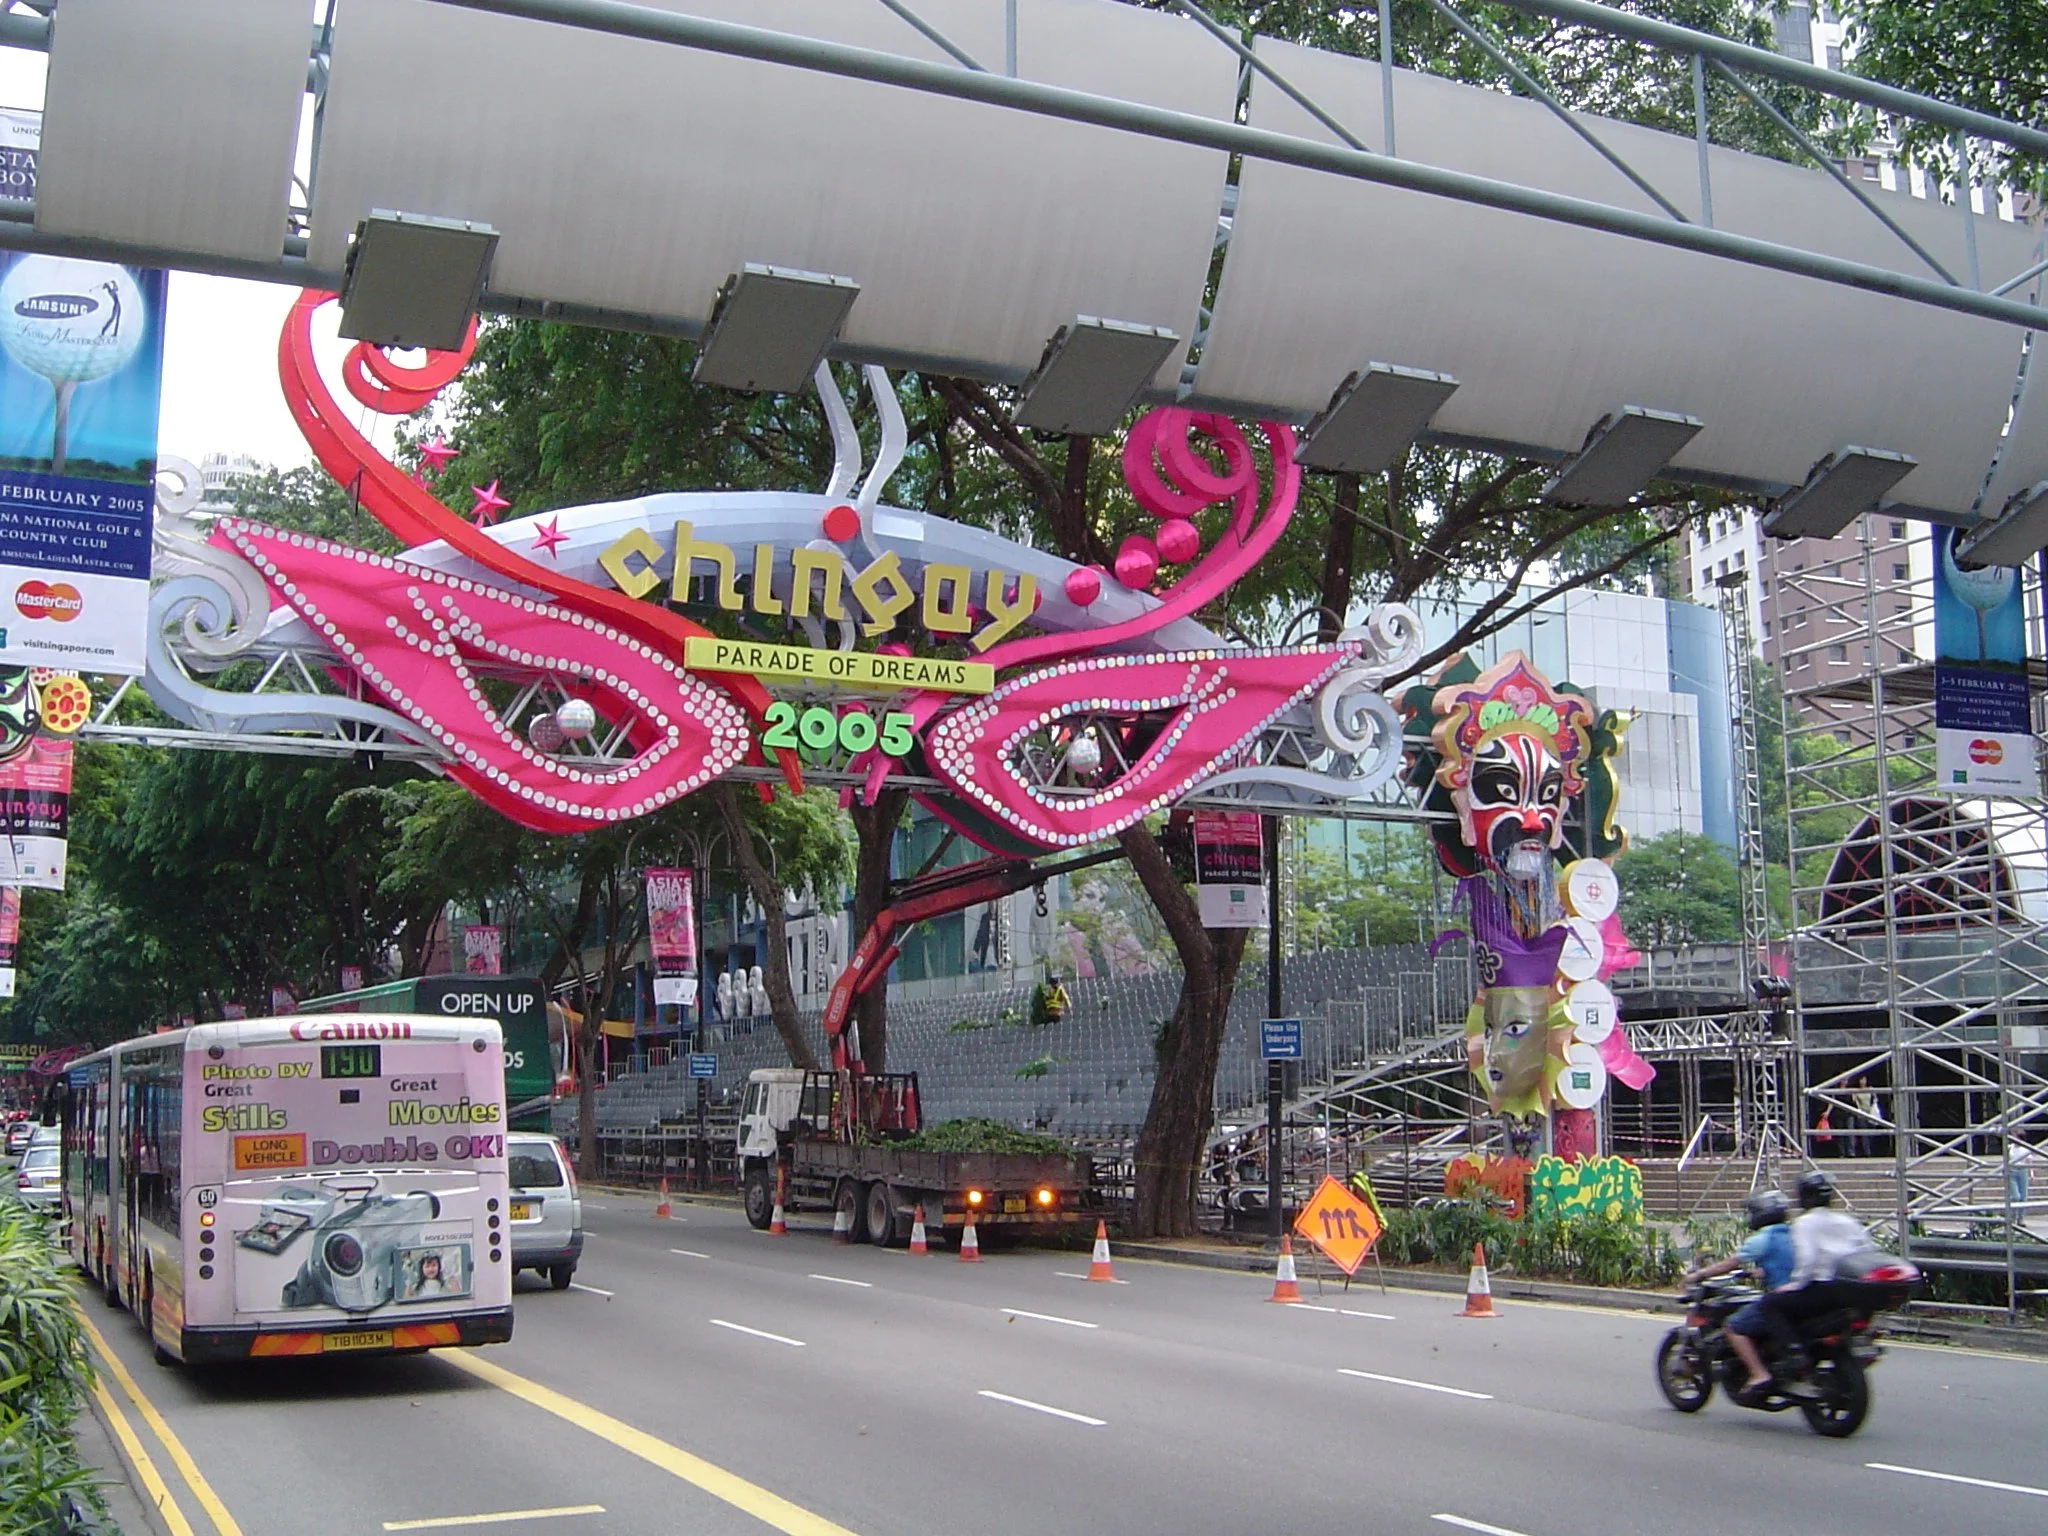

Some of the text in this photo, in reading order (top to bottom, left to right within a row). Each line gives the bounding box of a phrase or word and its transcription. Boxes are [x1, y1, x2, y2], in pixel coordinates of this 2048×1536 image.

[22, 297, 88, 316] SAMSUNG
[2, 484, 145, 513] FEBRUARY 2005
[24, 515, 92, 532] NATIONAL
[97, 523, 130, 536] GOLF
[134, 529, 143, 538] &
[0, 529, 109, 549] COUNTRY CLUB
[17, 592, 81, 611] MasterCard
[23, 640, 115, 657] visitsingapore.com
[715, 646, 967, 685] PARADE OF DREAMS
[1957, 678, 2005, 690] FEBRUARY
[763, 701, 915, 757] 2005
[29, 819, 61, 831] DREAMS
[647, 876, 692, 888] ASIA'S
[441, 993, 533, 1014] OPEN UP
[289, 1020, 411, 1041] Canon
[203, 1061, 313, 1081] Photo DV
[204, 1084, 253, 1098] Great
[390, 1078, 438, 1092] Great
[203, 1103, 288, 1132] Stills
[388, 1096, 500, 1126] Movies
[252, 1139, 288, 1151] LONG
[312, 1134, 504, 1165] Double OK!
[244, 1151, 297, 1164] VEHICLE
[201, 1190, 215, 1203] 60
